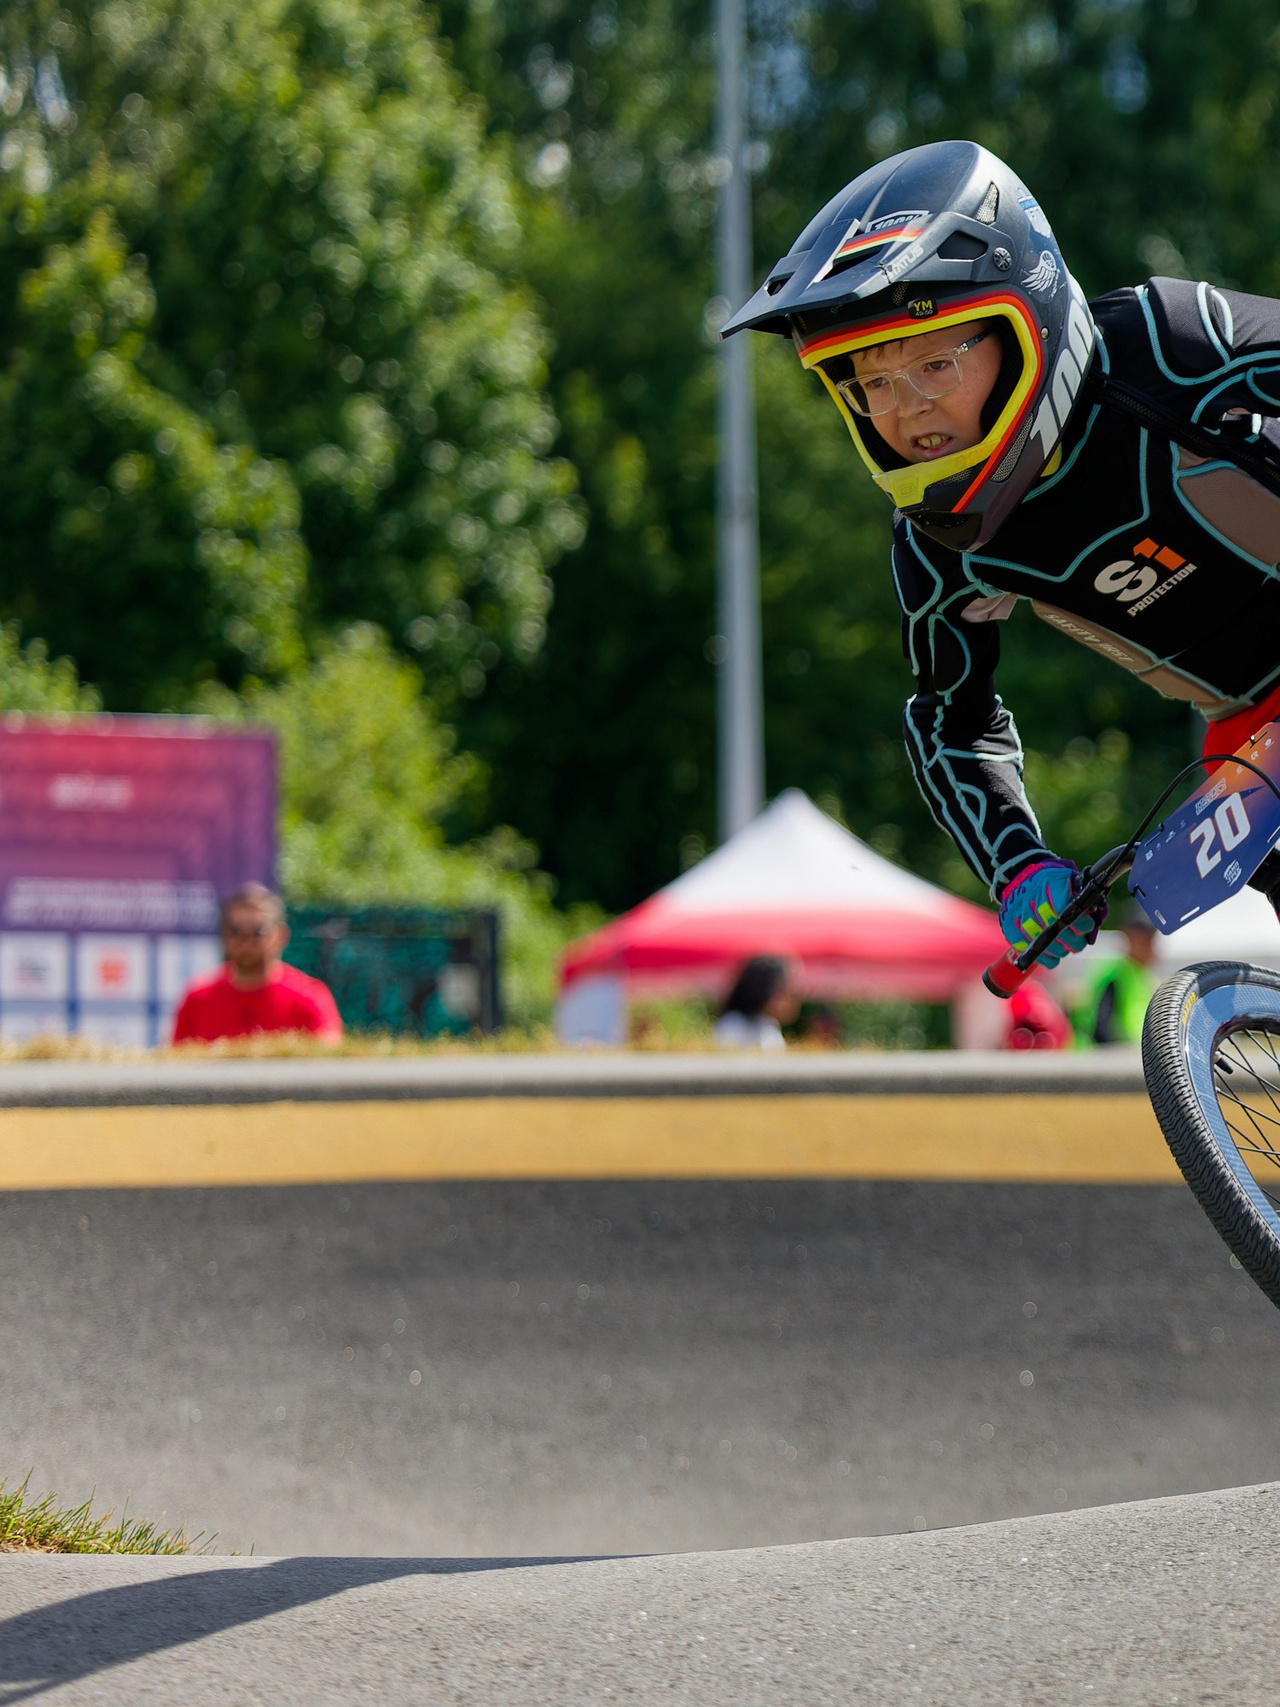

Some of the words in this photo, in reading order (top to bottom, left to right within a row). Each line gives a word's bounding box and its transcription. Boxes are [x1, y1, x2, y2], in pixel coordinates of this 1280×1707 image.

[913, 299, 933, 312] YM
[1126, 562, 1198, 617] PROTECTION
[1189, 792, 1251, 879] 20
